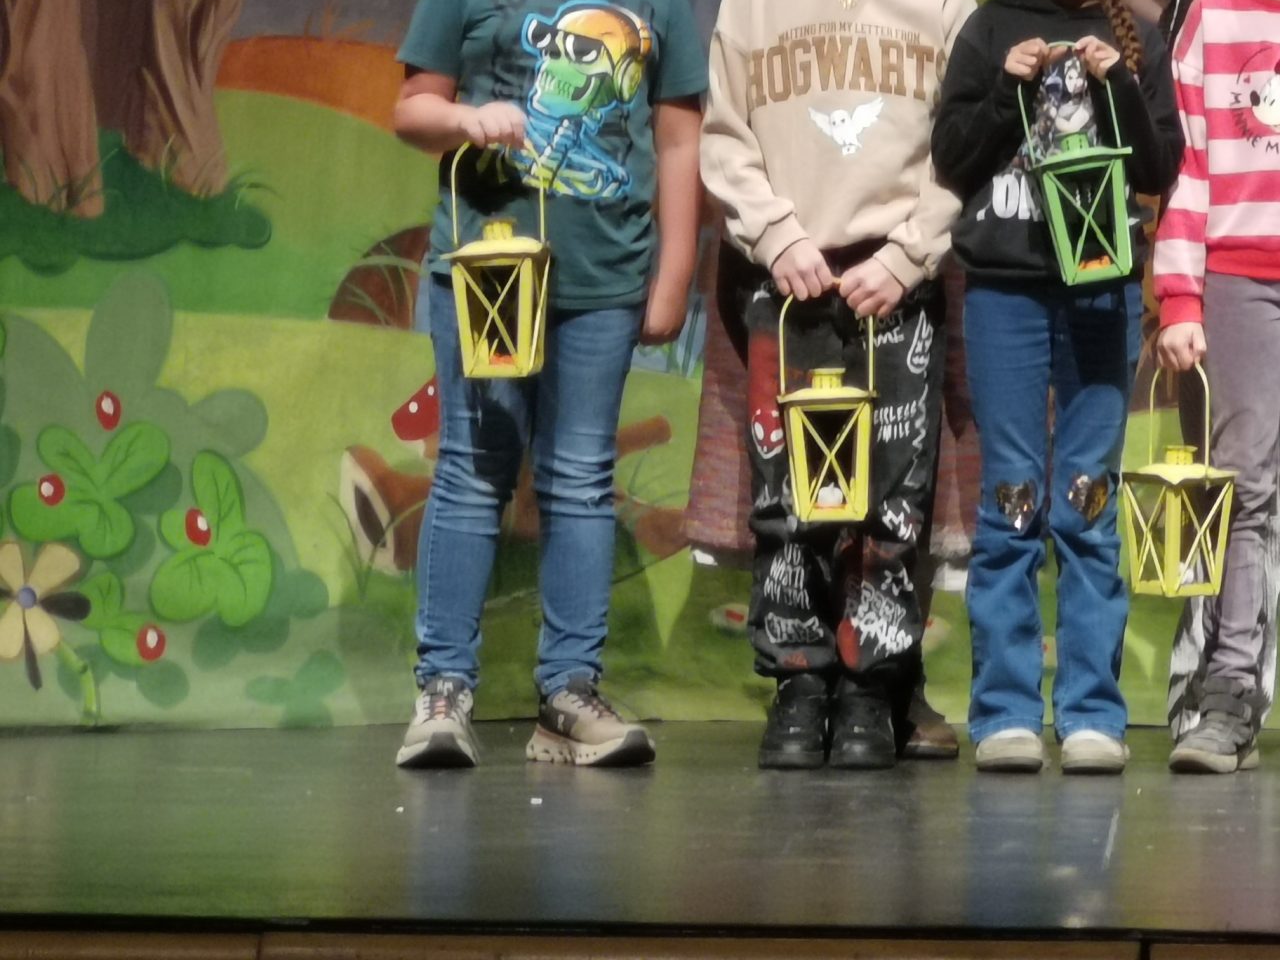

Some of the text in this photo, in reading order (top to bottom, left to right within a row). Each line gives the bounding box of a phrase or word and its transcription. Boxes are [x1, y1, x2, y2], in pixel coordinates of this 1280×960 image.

[818, 22, 836, 35] FOR
[839, 21, 853, 34] MY
[854, 23, 893, 36] LETTER
[895, 29, 921, 44] FROM
